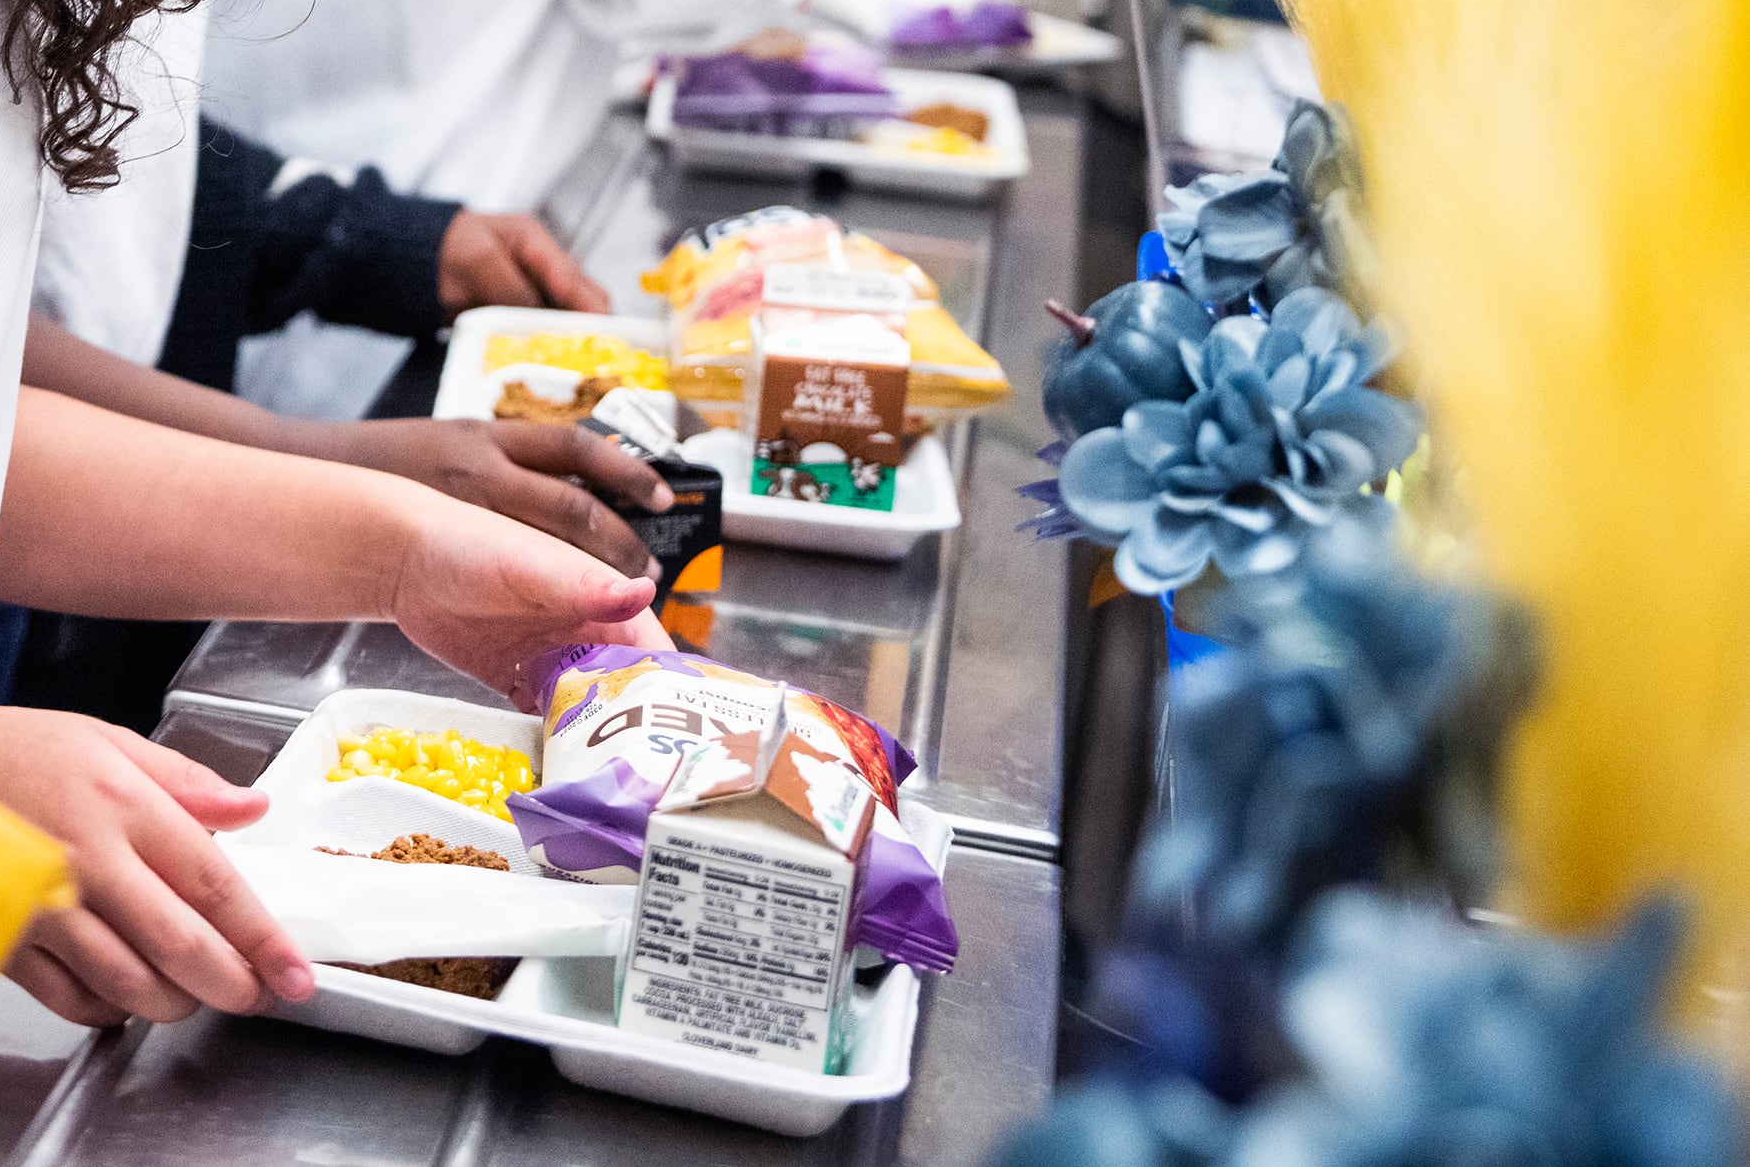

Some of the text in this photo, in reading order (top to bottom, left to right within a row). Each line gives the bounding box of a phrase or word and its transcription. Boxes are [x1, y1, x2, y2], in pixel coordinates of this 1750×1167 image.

[674, 691, 706, 710] FAT
[714, 703, 772, 727] LESS
[650, 850, 700, 872] Nutrition
[648, 866, 679, 884] Facts
[704, 990, 718, 1000] FAT
[722, 993, 740, 1004] FREE
